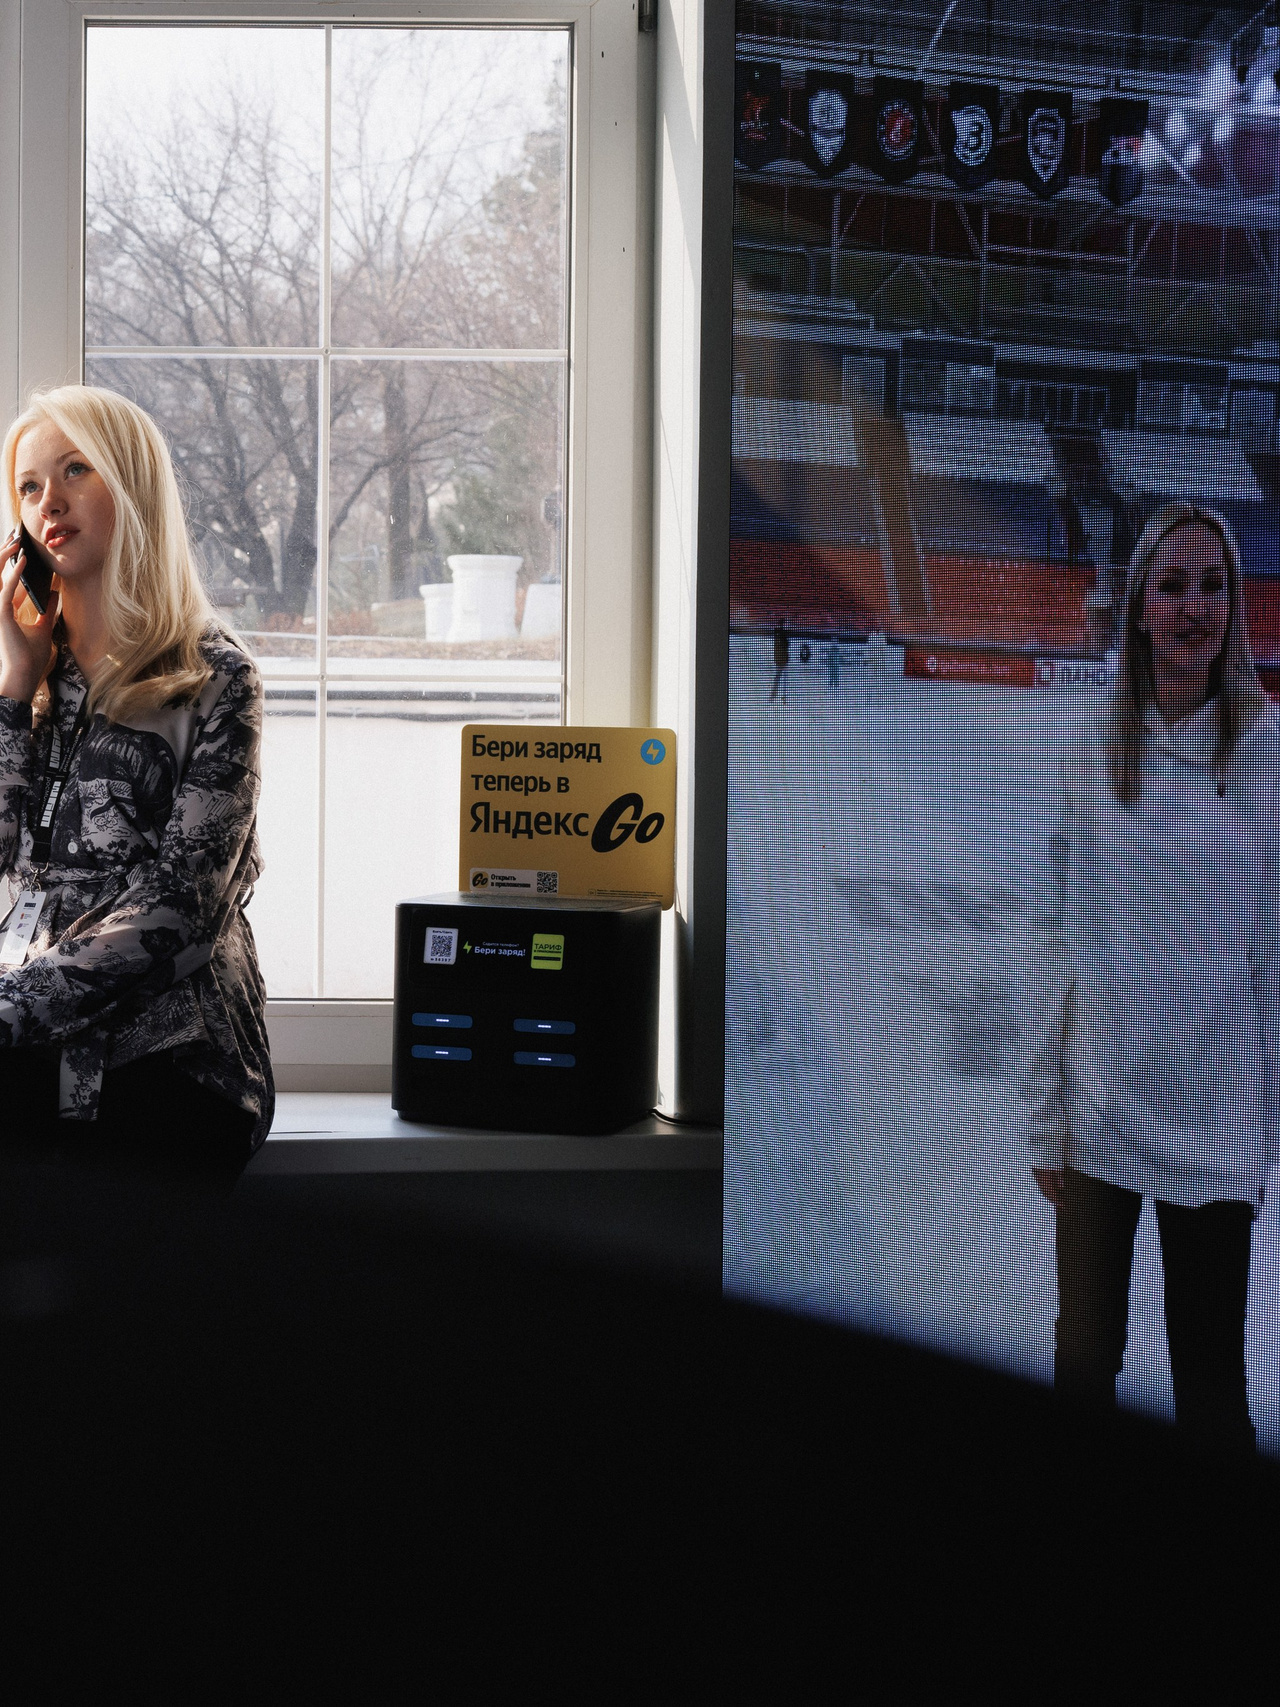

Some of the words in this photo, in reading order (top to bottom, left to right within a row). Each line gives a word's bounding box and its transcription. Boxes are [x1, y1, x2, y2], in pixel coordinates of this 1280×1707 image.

[471, 734, 528, 761] Бери
[534, 742, 602, 763] заряд
[471, 774, 551, 796] теперь
[557, 776, 570, 793] в
[470, 802, 590, 840] Яндекс
[591, 792, 665, 853] Go
[472, 873, 488, 887] Go
[490, 873, 517, 881] Открыть
[474, 946, 496, 955] Бери
[497, 948, 526, 957] заряд!
